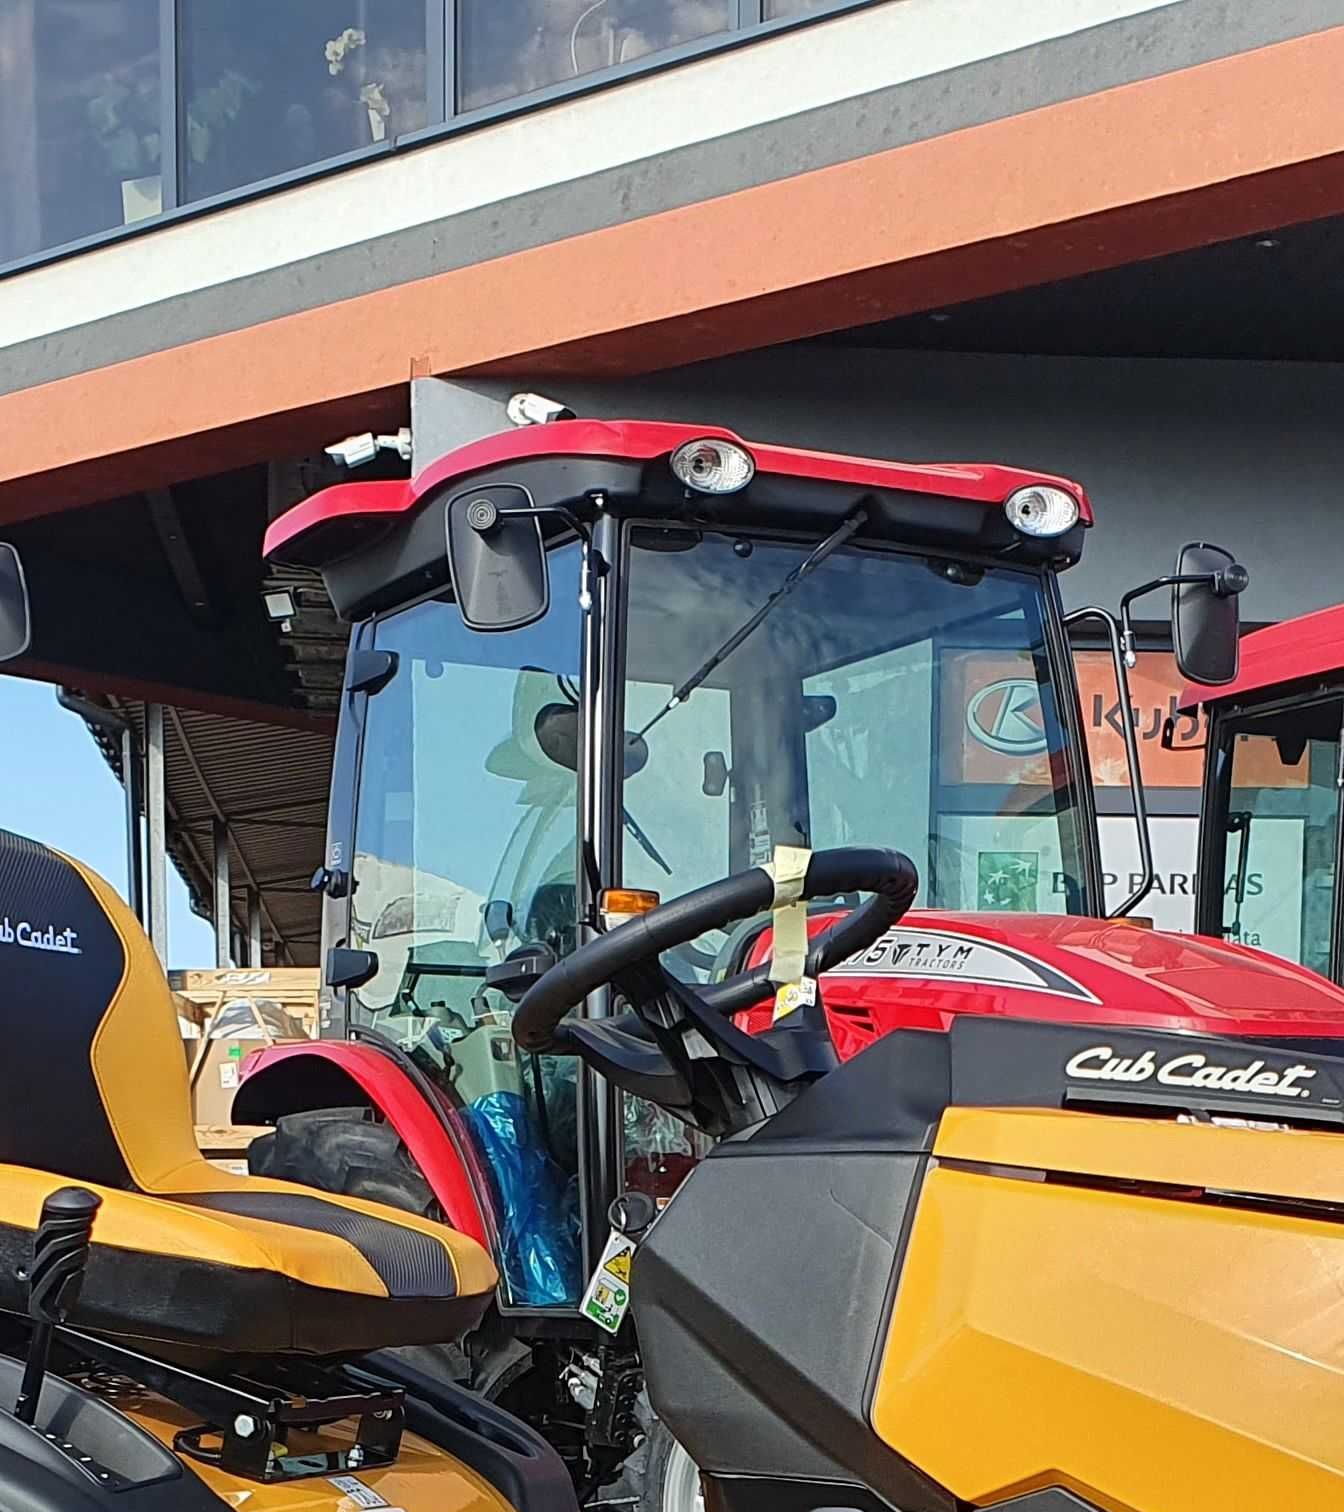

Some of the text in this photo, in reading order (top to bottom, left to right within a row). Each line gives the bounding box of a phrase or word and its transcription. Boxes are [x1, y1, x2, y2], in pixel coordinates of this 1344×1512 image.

[16, 922, 83, 954] Cadet
[908, 956, 966, 971] TRACTORS
[915, 943, 974, 961] TYM
[1065, 1046, 1317, 1097] Cub Cadet
